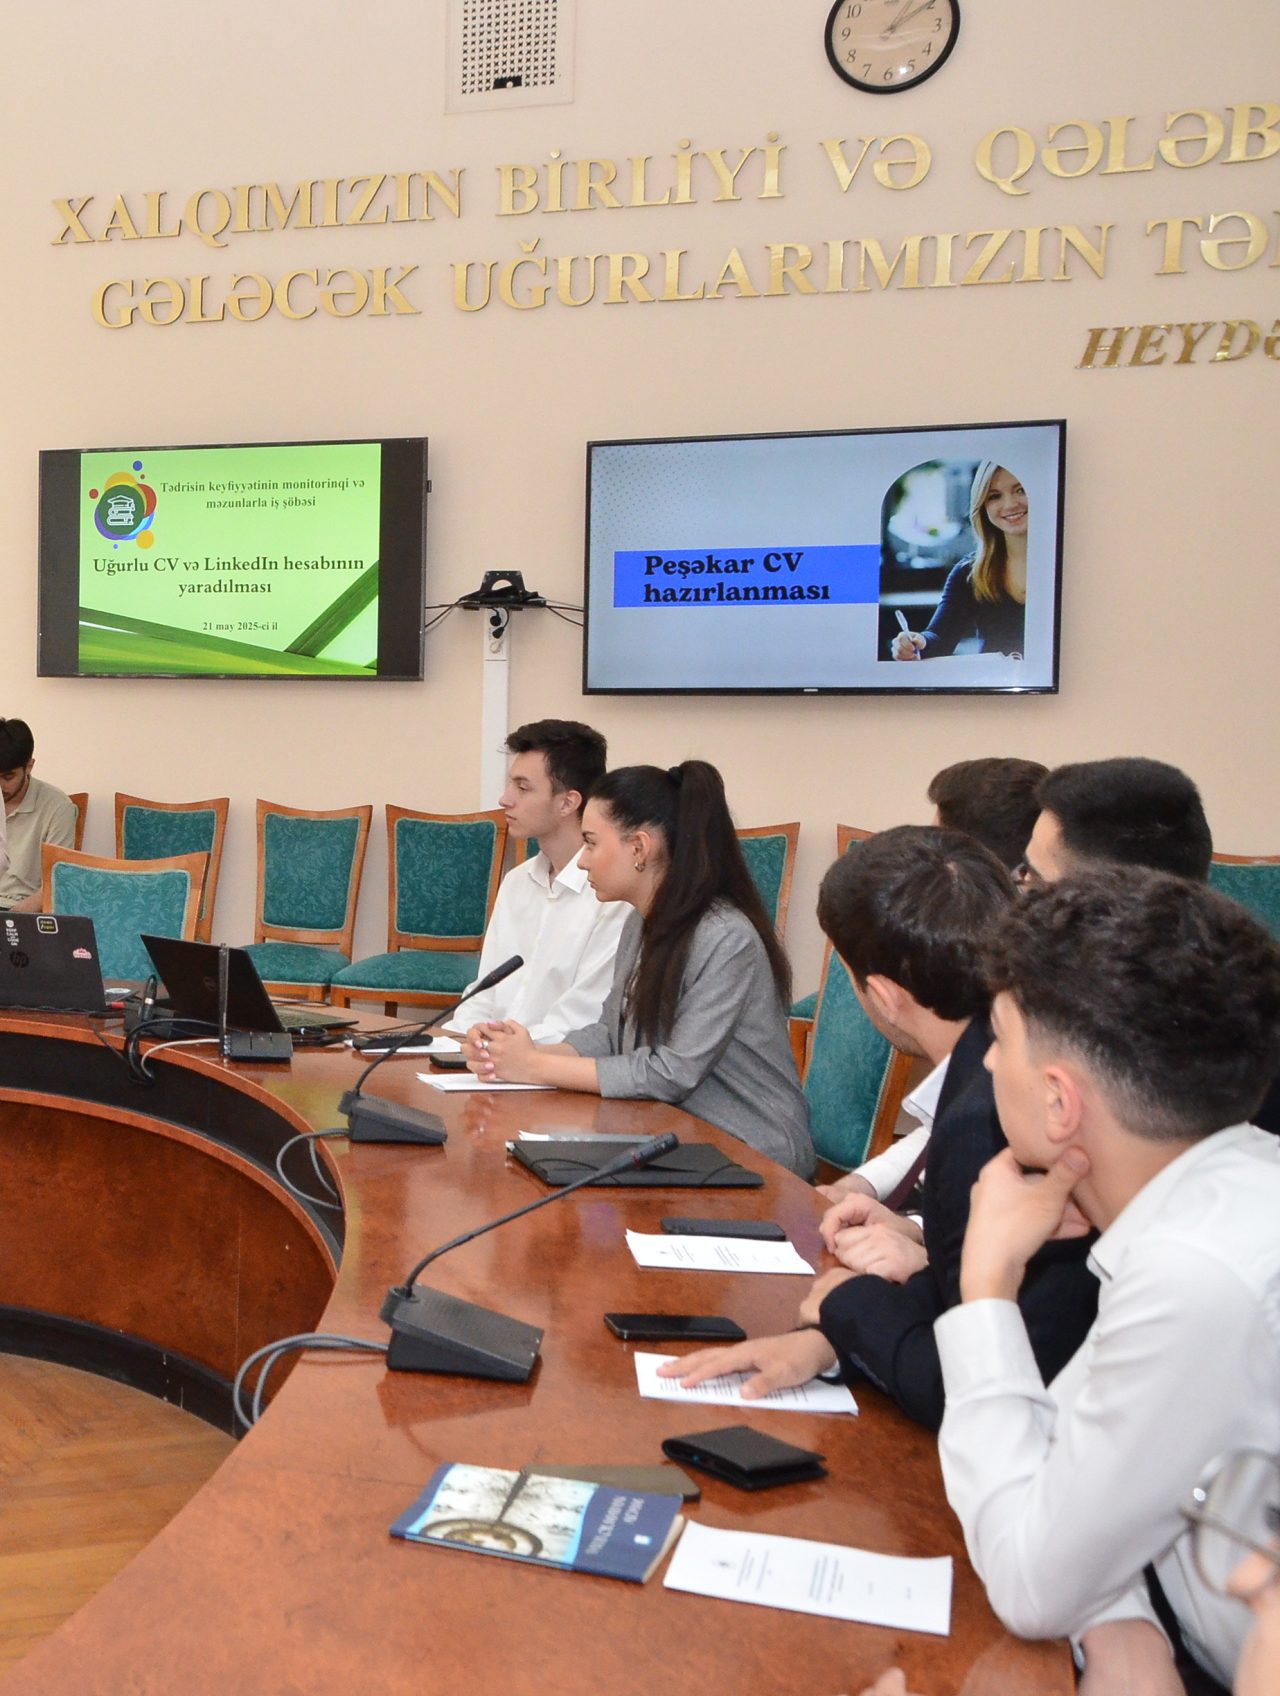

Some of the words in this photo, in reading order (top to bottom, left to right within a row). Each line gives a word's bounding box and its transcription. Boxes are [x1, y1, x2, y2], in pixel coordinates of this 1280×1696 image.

[846, 4, 862, 19] 10
[932, 18, 942, 33] 3
[841, 27, 851, 41] 9
[846, 48, 856, 63] 8
[922, 41, 932, 56] 4
[863, 63, 872, 78] 7
[883, 66, 893, 81] 6
[907, 59, 916, 73] 5
[50, 167, 467, 249] XALQIMIZIN
[495, 130, 787, 217] BİRLİYİ
[819, 133, 933, 193] VƏ
[975, 102, 1280, 196] QƏLƏB
[90, 264, 422, 330] GƏLƏCƏK
[450, 221, 1117, 312] UĞURLARIMIZIN
[160, 481, 205, 492] Tədrisin
[209, 480, 279, 494] keyfiyyətinin
[353, 480, 365, 488] və
[206, 498, 267, 509] məzunlarla
[271, 497, 279, 509] iş
[282, 496, 316, 509] şöbəsi
[93, 558, 149, 576] Uğurlu
[153, 557, 178, 572] CV
[183, 560, 199, 572] və
[204, 556, 279, 571] LinkedIn
[284, 556, 365, 570] hesabının
[644, 554, 755, 579] Peşəkar
[763, 552, 804, 573] CV
[178, 579, 272, 597] yaradılması
[643, 582, 831, 603] hazırlanması
[202, 622, 213, 631] 21
[215, 623, 234, 632] may
[237, 621, 270, 631] 2025-ci
[272, 621, 278, 631] il
